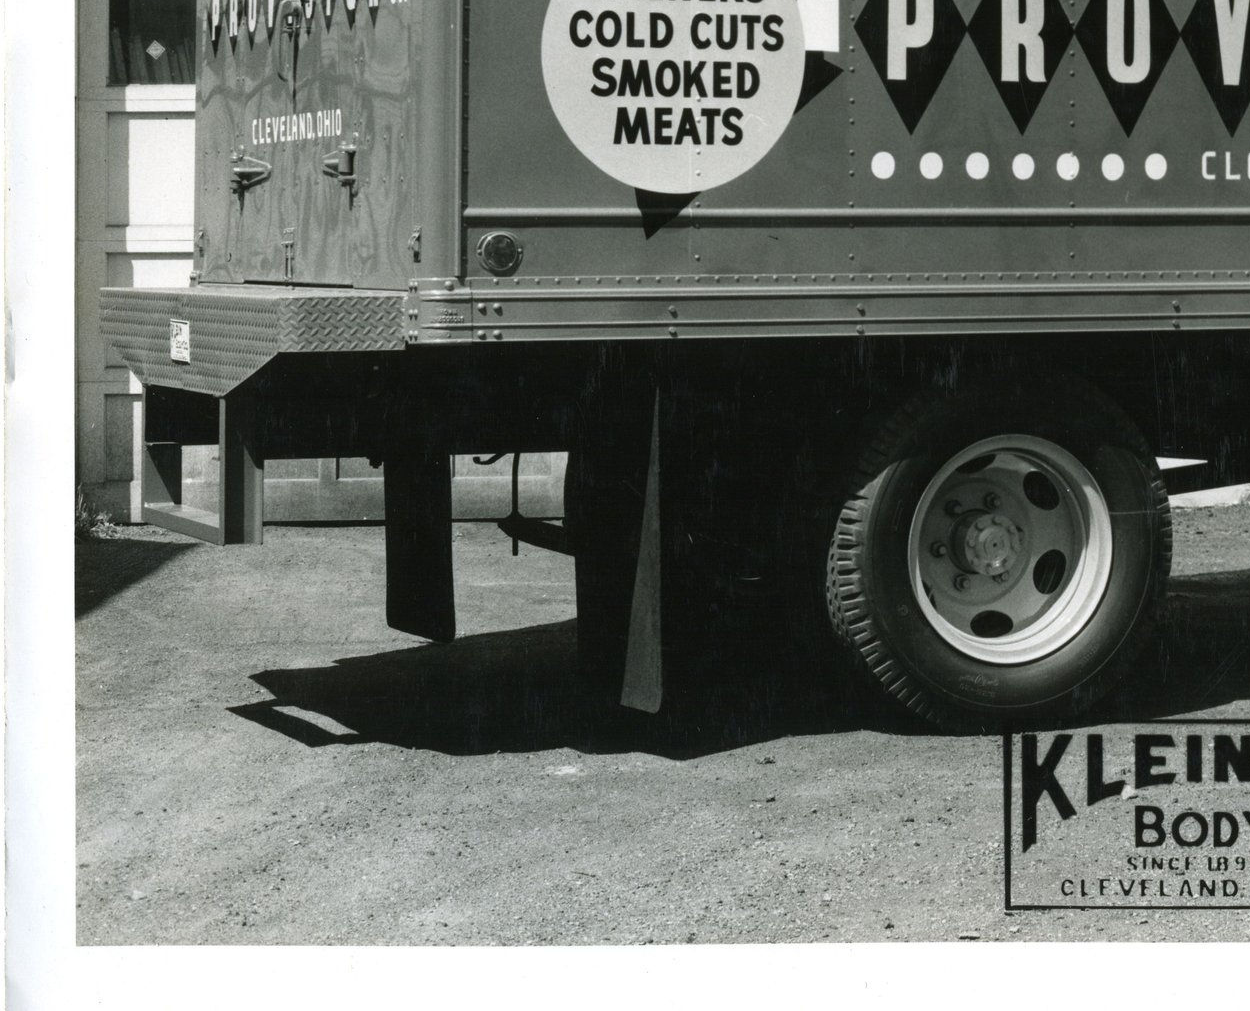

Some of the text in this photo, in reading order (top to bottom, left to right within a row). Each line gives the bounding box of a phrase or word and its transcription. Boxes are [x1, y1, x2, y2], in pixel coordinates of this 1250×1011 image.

[569, 9, 785, 52] COLD CUTS
[590, 57, 761, 99] SMOKED
[252, 108, 342, 146] CLEVELAND, OHIO
[613, 106, 745, 147] MEATS
